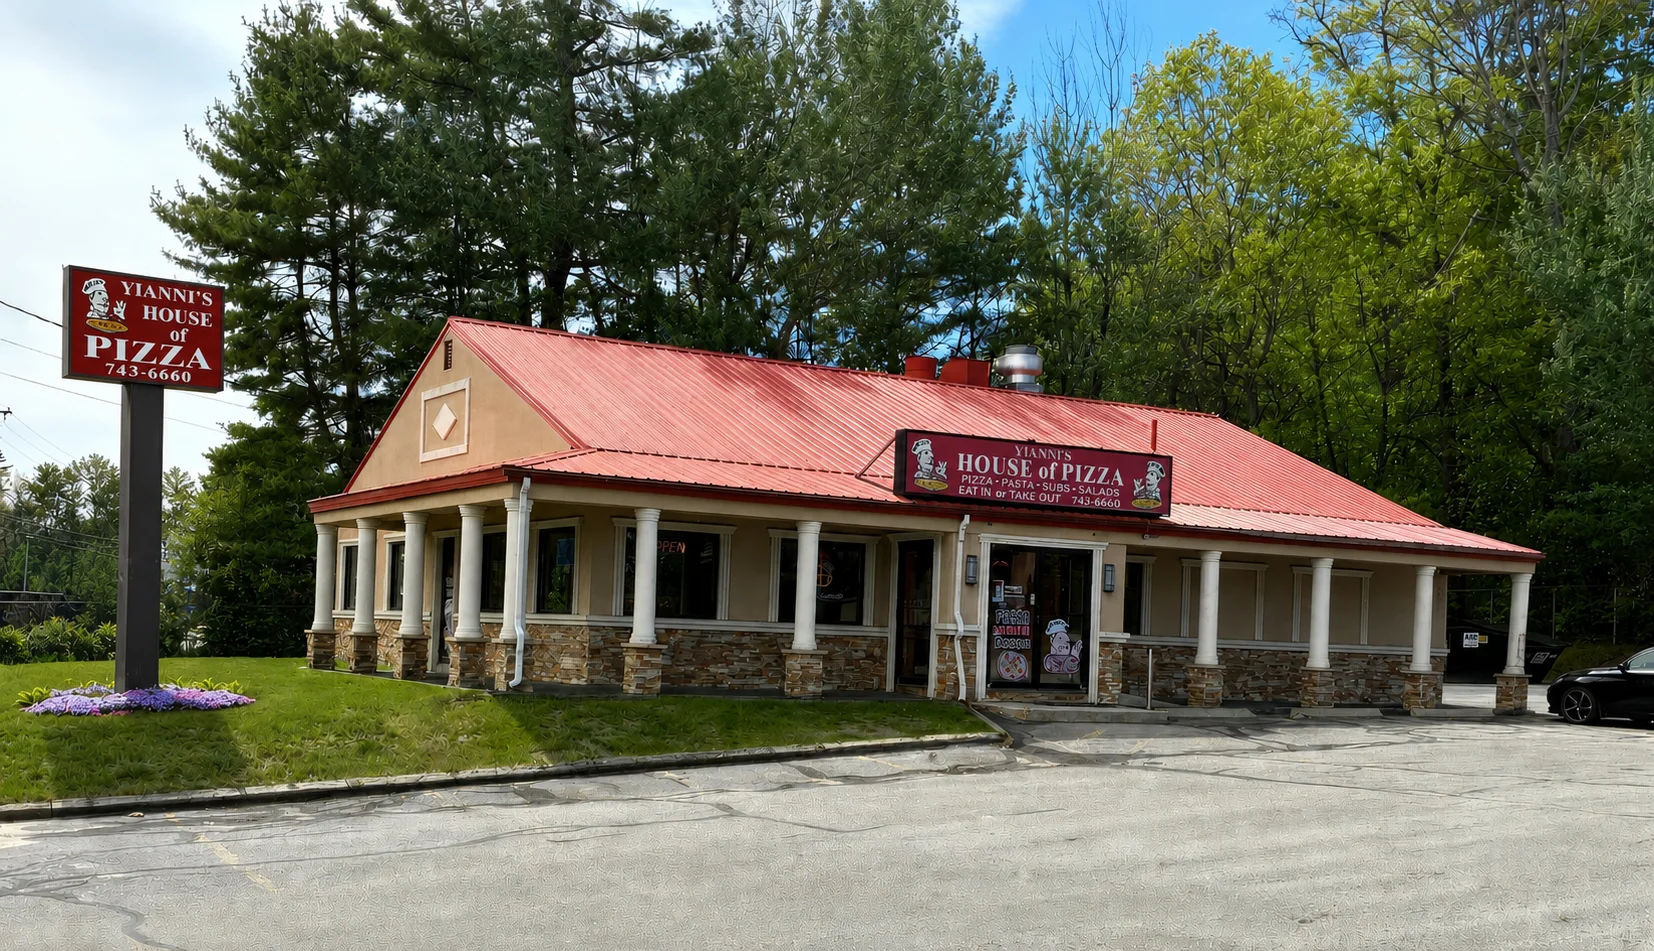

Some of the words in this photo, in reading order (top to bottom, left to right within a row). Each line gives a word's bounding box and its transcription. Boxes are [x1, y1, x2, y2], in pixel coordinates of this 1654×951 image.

[121, 281, 212, 306] YIANNI'S
[142, 305, 212, 327] HOUSE
[170, 328, 188, 342] of
[84, 334, 212, 370] PIZZA
[106, 363, 191, 382] 743-6660
[1015, 445, 1072, 460] YIANNI'S
[957, 453, 1032, 477] HOUSE
[1039, 463, 1057, 480] of
[1061, 463, 1124, 486] PIZZA
[959, 485, 978, 496] EAT
[980, 487, 991, 497] IN
[996, 490, 1006, 498] or
[1010, 491, 1035, 501] TAKE
[1038, 493, 1060, 503] OUT
[1072, 496, 1120, 508] 743-6660
[962, 474, 992, 485] PIZZA
[1002, 478, 1034, 489] PASTA
[1042, 482, 1070, 493] SUBS
[1078, 486, 1120, 497] SALADS
